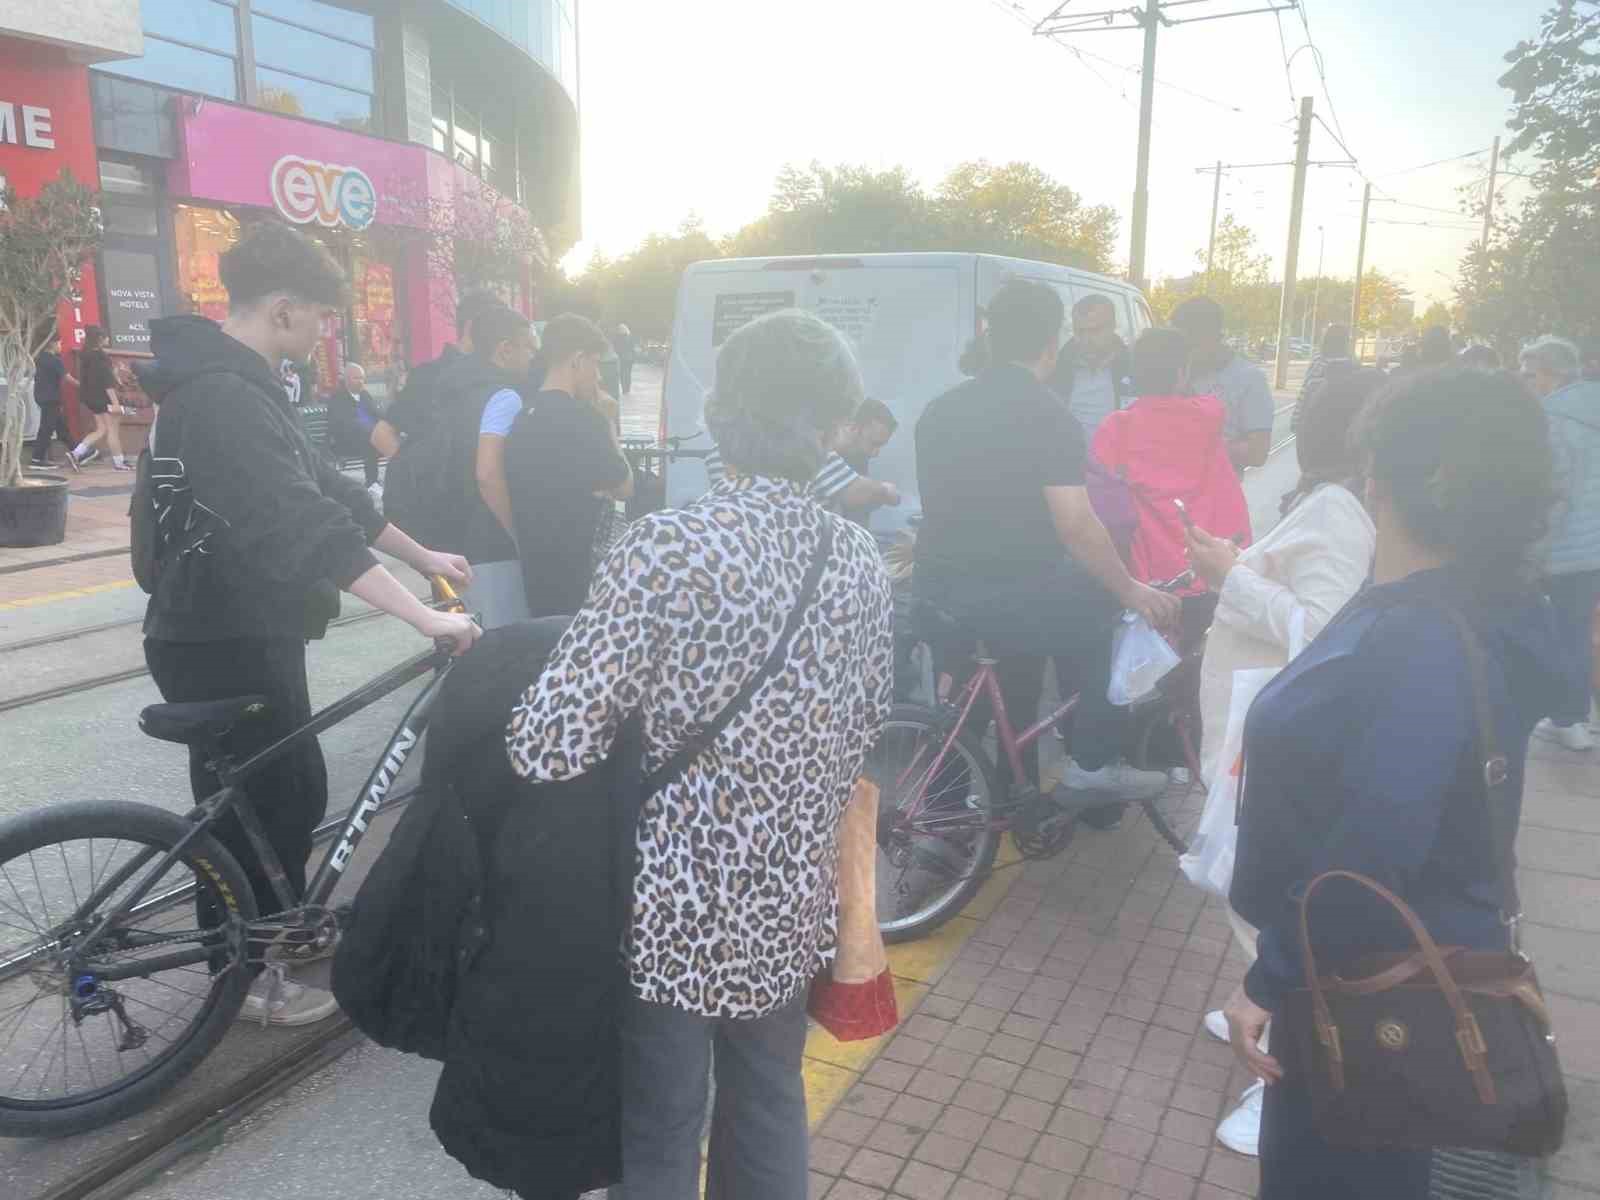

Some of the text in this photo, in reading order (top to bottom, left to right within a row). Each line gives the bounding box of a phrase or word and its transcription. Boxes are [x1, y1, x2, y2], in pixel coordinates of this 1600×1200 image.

[273, 156, 375, 229] eve
[111, 289, 132, 297] NOVA
[119, 300, 151, 309] HOTELS
